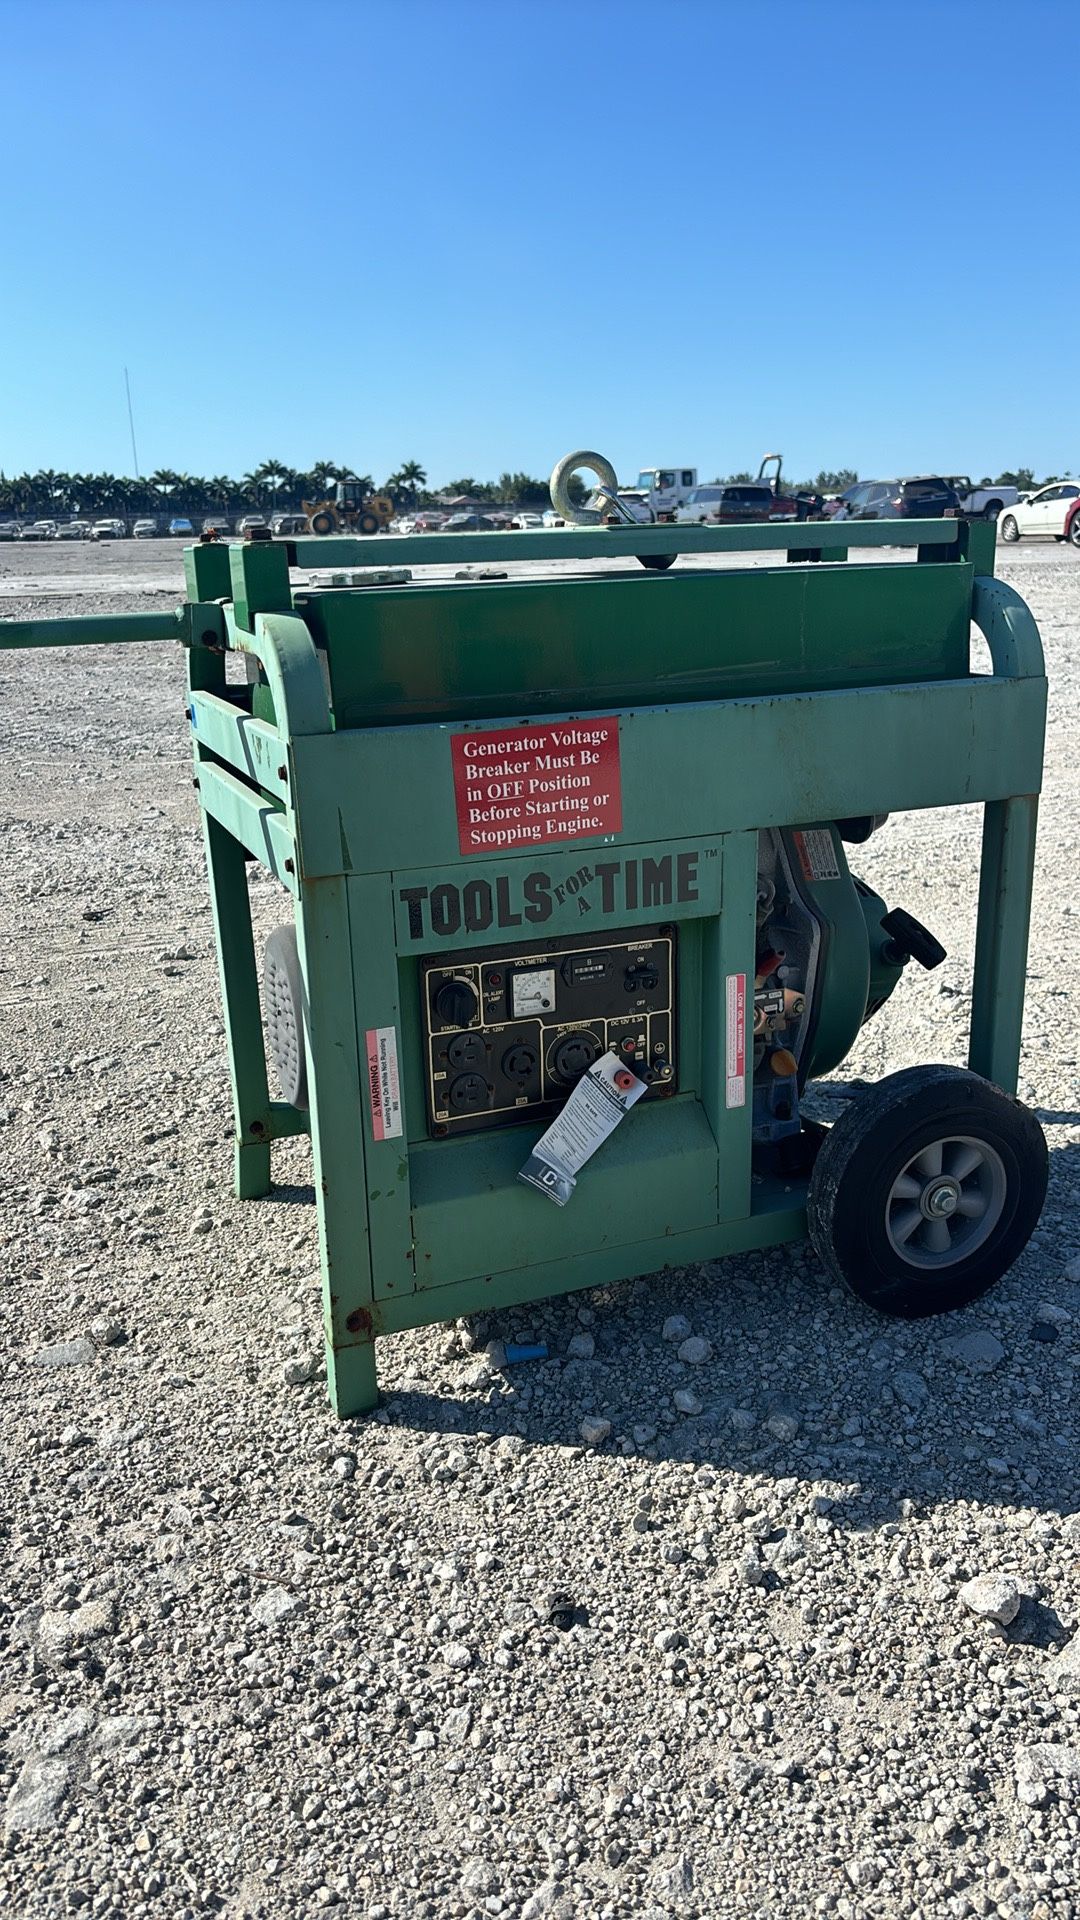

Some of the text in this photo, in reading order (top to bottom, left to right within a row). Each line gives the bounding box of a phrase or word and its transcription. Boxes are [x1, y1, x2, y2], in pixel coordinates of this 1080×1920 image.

[463, 728, 608, 758] Generator Voltage
[465, 750, 600, 780] Breaker Must Be
[467, 775, 591, 802] in OFF Position
[469, 793, 610, 824] Before Starting or
[470, 816, 603, 845] Stopping Engine.
[399, 870, 553, 940] TOOLS
[553, 864, 595, 906] FOR
[576, 895, 592, 917] A
[595, 851, 699, 914] TIME
[514, 958, 548, 966] VOLTMETER
[627, 943, 653, 952] BREAKER
[370, 1065, 381, 1108] WARNING
[382, 1088, 389, 1096] On
[600, 1077, 622, 1099] CAUTION
